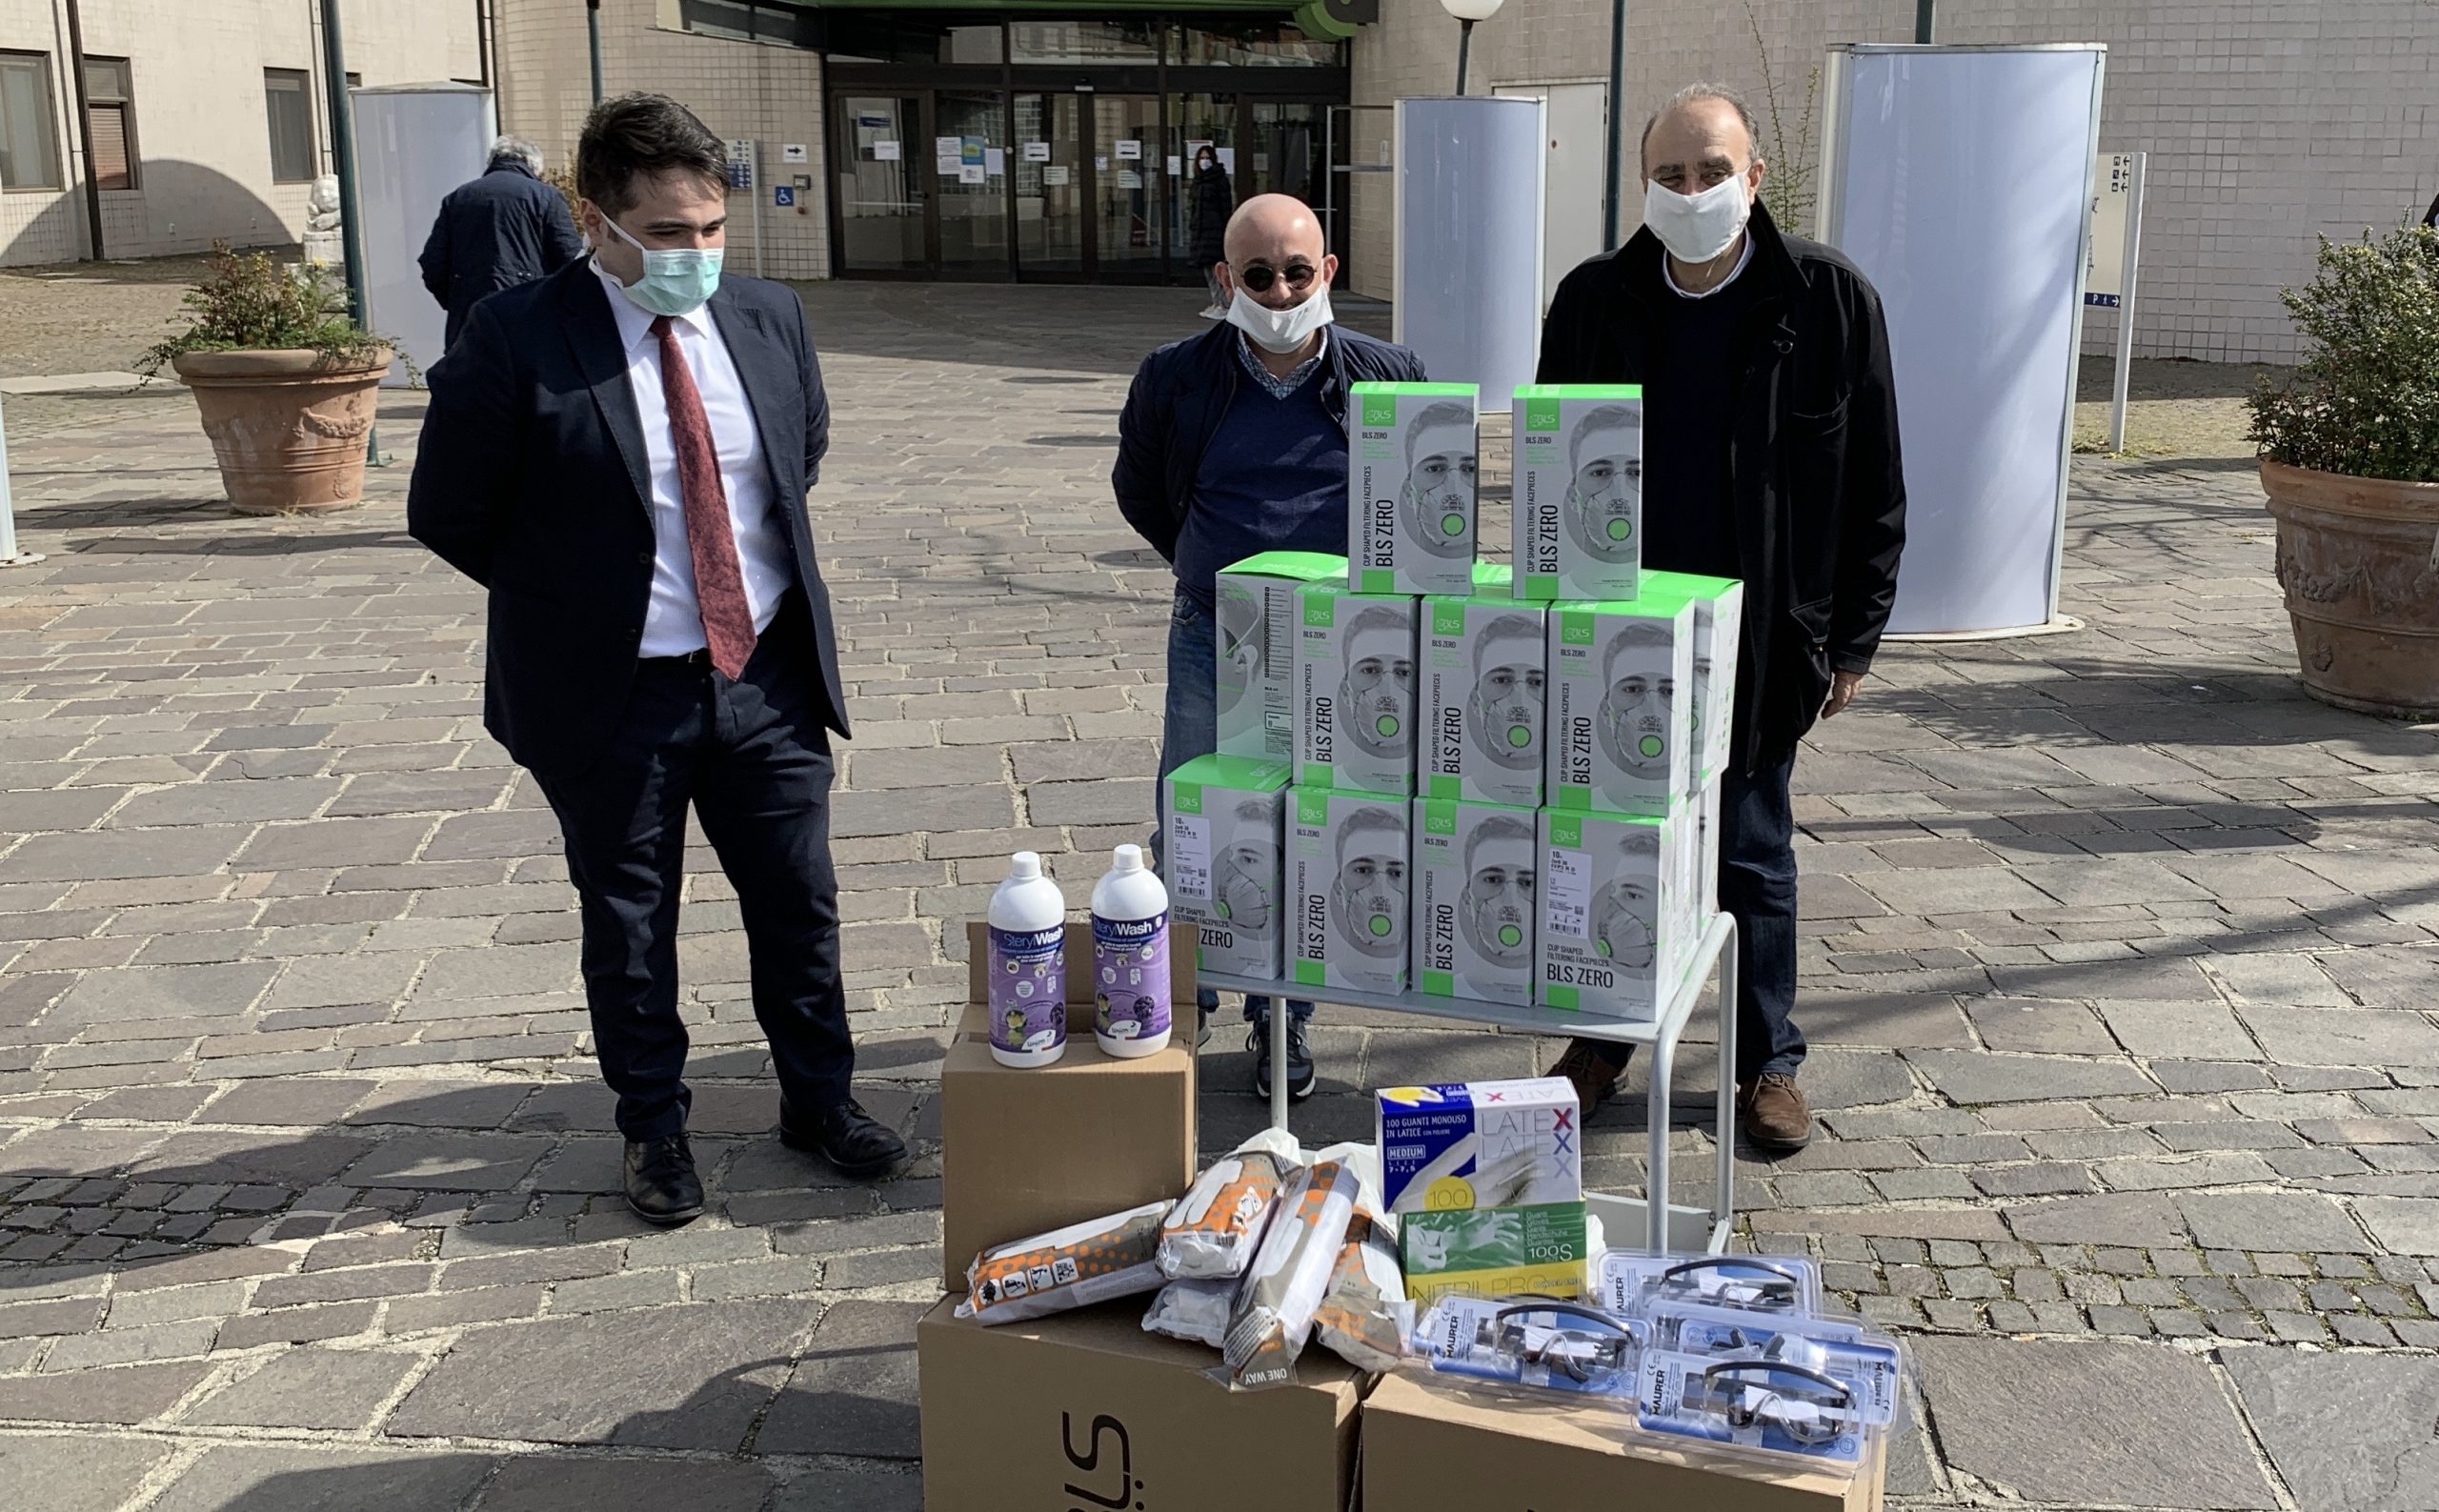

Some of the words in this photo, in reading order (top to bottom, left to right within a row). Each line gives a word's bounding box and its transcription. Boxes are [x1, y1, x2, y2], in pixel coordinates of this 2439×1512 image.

[2092, 294, 2098, 304] P
[1362, 466, 1371, 500] FACEPIECES
[1362, 501, 1371, 530] FILTERING
[1376, 500, 1393, 536] ZERO
[1540, 505, 1558, 542] ZERO
[1362, 531, 1371, 554] SHAPED
[1376, 540, 1393, 567] BLS
[1362, 554, 1371, 567] CUP
[1540, 546, 1558, 573] BLS
[1442, 640, 1456, 649] ZERO
[1316, 697, 1332, 734] ZERO
[1443, 707, 1461, 743] ZERO
[1573, 717, 1590, 754] ZERO
[1316, 736, 1332, 763] BLS
[1443, 747, 1461, 774] BLS
[1573, 757, 1590, 784] BLS
[1435, 838, 1448, 847] ZERO
[1174, 914, 1199, 923] FILTERING
[1199, 917, 1229, 928] FACEPIECES
[1175, 906, 1185, 915] CUP
[1186, 907, 1206, 917] SHAPED
[1308, 895, 1324, 931] ZERO
[1436, 904, 1452, 941] ZERO
[1003, 926, 1064, 949] SterylWash
[1201, 929, 1233, 949] ZERO
[1308, 933, 1324, 959] BLS
[1547, 943, 1559, 952] CUP
[1560, 945, 1583, 956] SHAPED
[1436, 943, 1452, 971] BLS
[1547, 952, 1574, 963] FILTERING
[1575, 956, 1610, 967] FACEPIECES
[1547, 963, 1573, 983] BLS
[1578, 967, 1614, 989] ZERO
[1386, 1119, 1401, 1129] 100
[1401, 1117, 1429, 1127] GUANTI
[1431, 1114, 1467, 1125] MONOUSO
[1386, 1129, 1396, 1139] IN
[1397, 1127, 1422, 1139] LATICE
[1481, 1107, 1574, 1136] LATEX
[1388, 1146, 1424, 1159] MEDIUM
[1430, 1188, 1468, 1209] 100
[1528, 1245, 1560, 1259] 100
[1560, 1243, 1573, 1262] S
[1446, 1316, 1460, 1359] MAURER
[1244, 1370, 1267, 1385] WAY
[1268, 1367, 1288, 1381] ONE
[1651, 1370, 1665, 1417] MAURER
